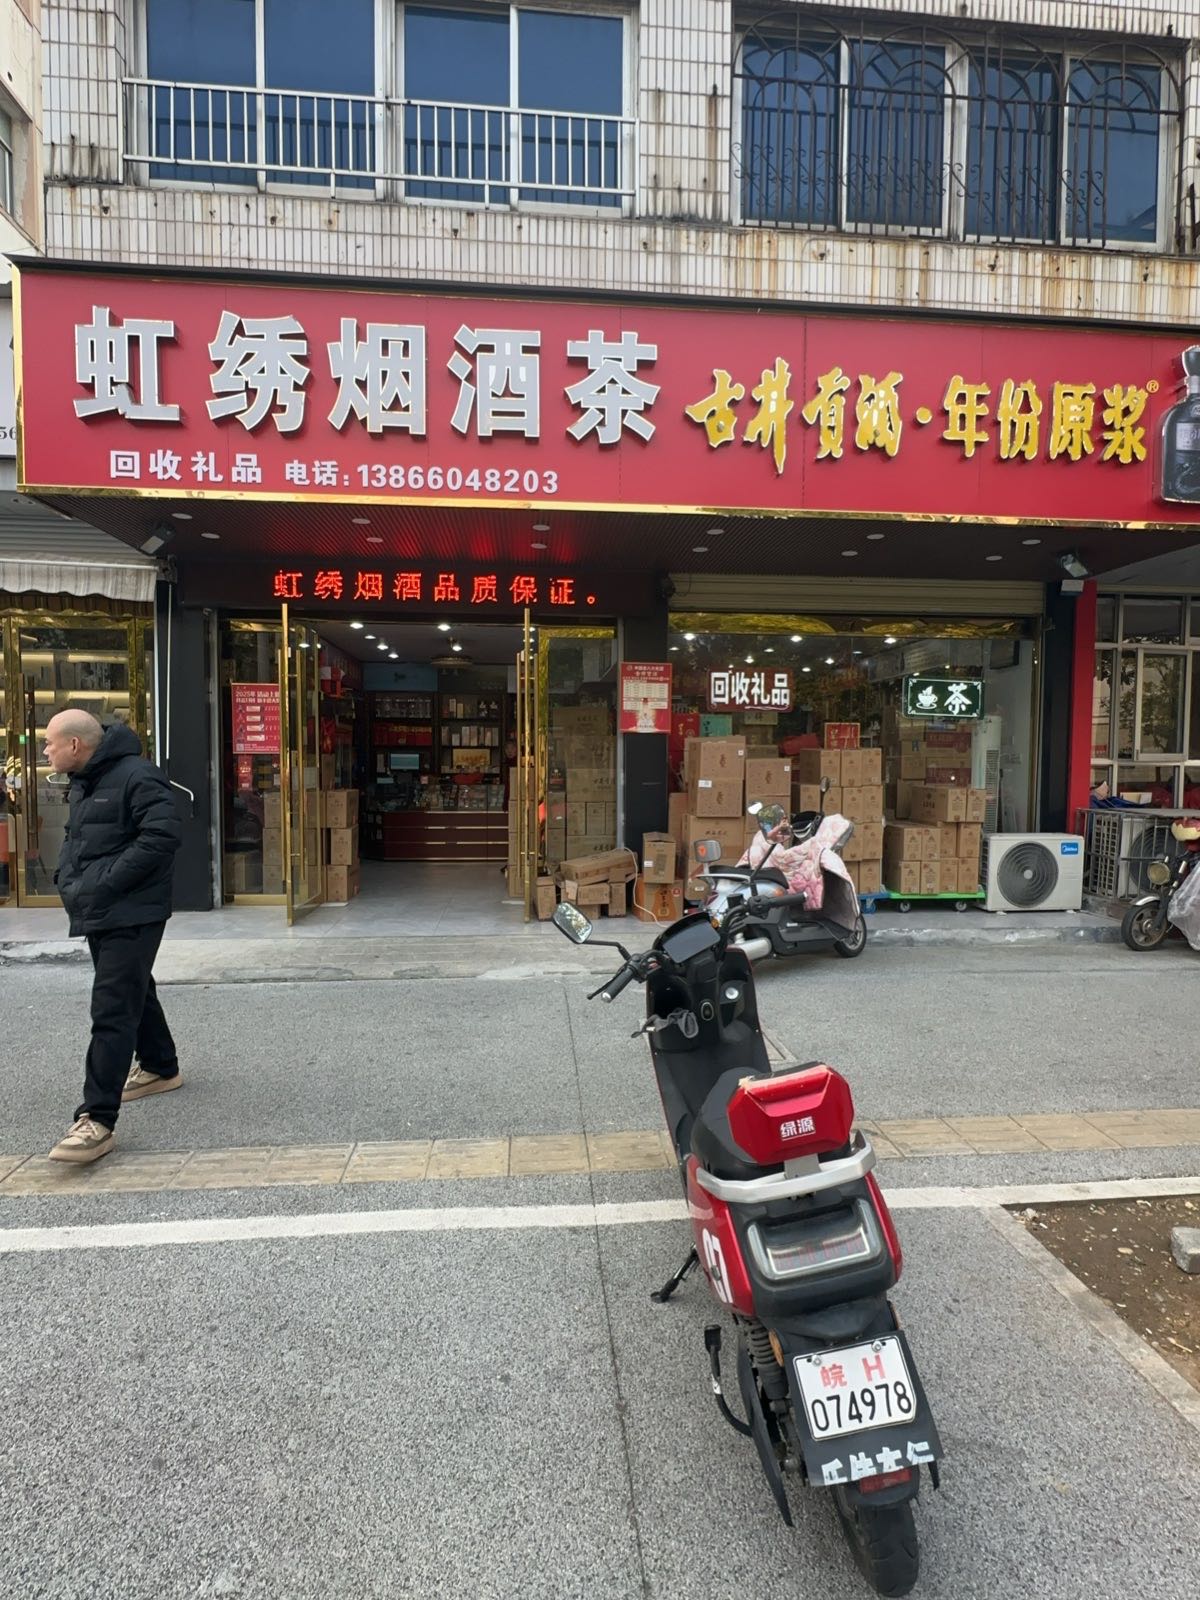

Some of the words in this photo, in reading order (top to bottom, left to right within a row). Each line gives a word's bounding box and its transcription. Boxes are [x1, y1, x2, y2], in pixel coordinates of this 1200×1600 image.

[73, 304, 661, 445] 虹绣烟酒茶
[109, 449, 262, 484] 回收礼品
[710, 672, 790, 706] 回收礼品
[944, 682, 972, 715] 茶
[780, 1115, 816, 1139] 绿源
[820, 1363, 848, 1389] 皖
[861, 1354, 886, 1382] H
[811, 1381, 912, 1432] 074978
